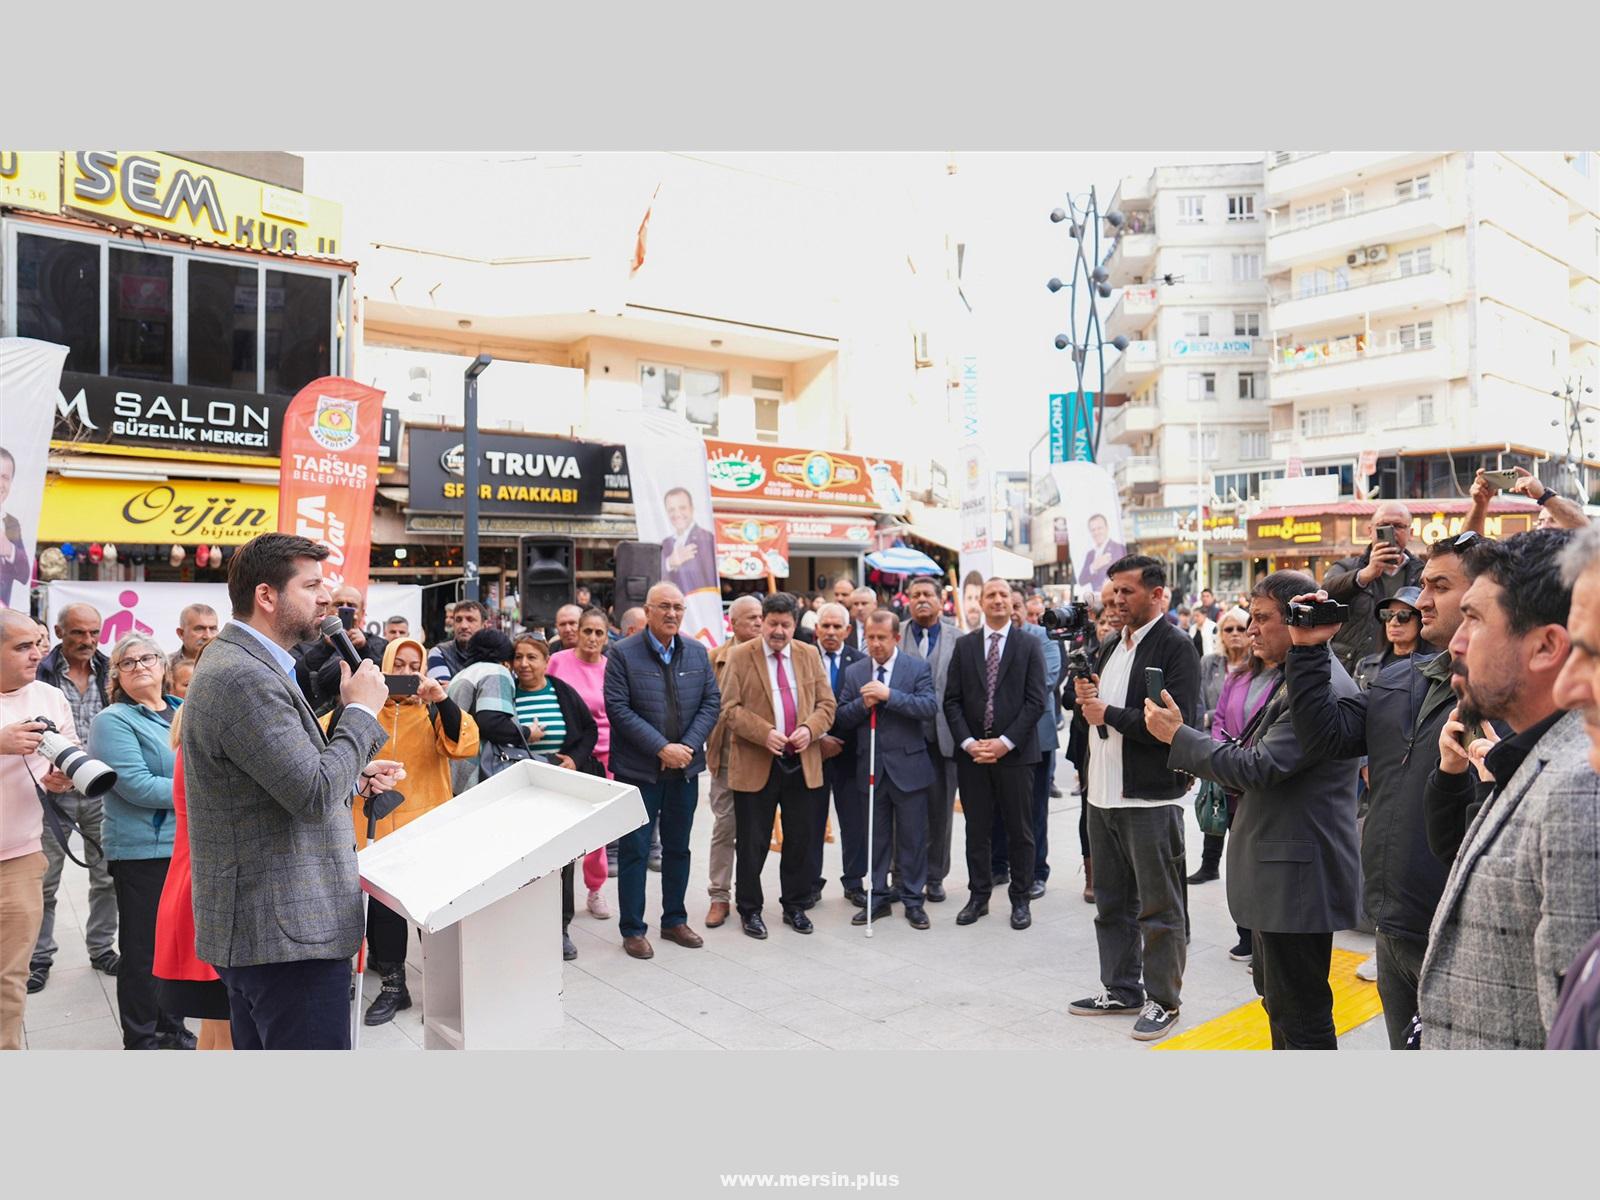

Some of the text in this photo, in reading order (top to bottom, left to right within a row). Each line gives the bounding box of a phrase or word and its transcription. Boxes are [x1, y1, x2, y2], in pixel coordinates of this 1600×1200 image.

[75, 152, 227, 232] SEM
[114, 391, 269, 430] SALON
[113, 418, 269, 447] GÜZELLİK MERKEZİ
[293, 454, 368, 480] TARSUS
[485, 451, 581, 480] TRUVA
[496, 486, 578, 503] AYAKKABI
[122, 485, 271, 537] Orjin
